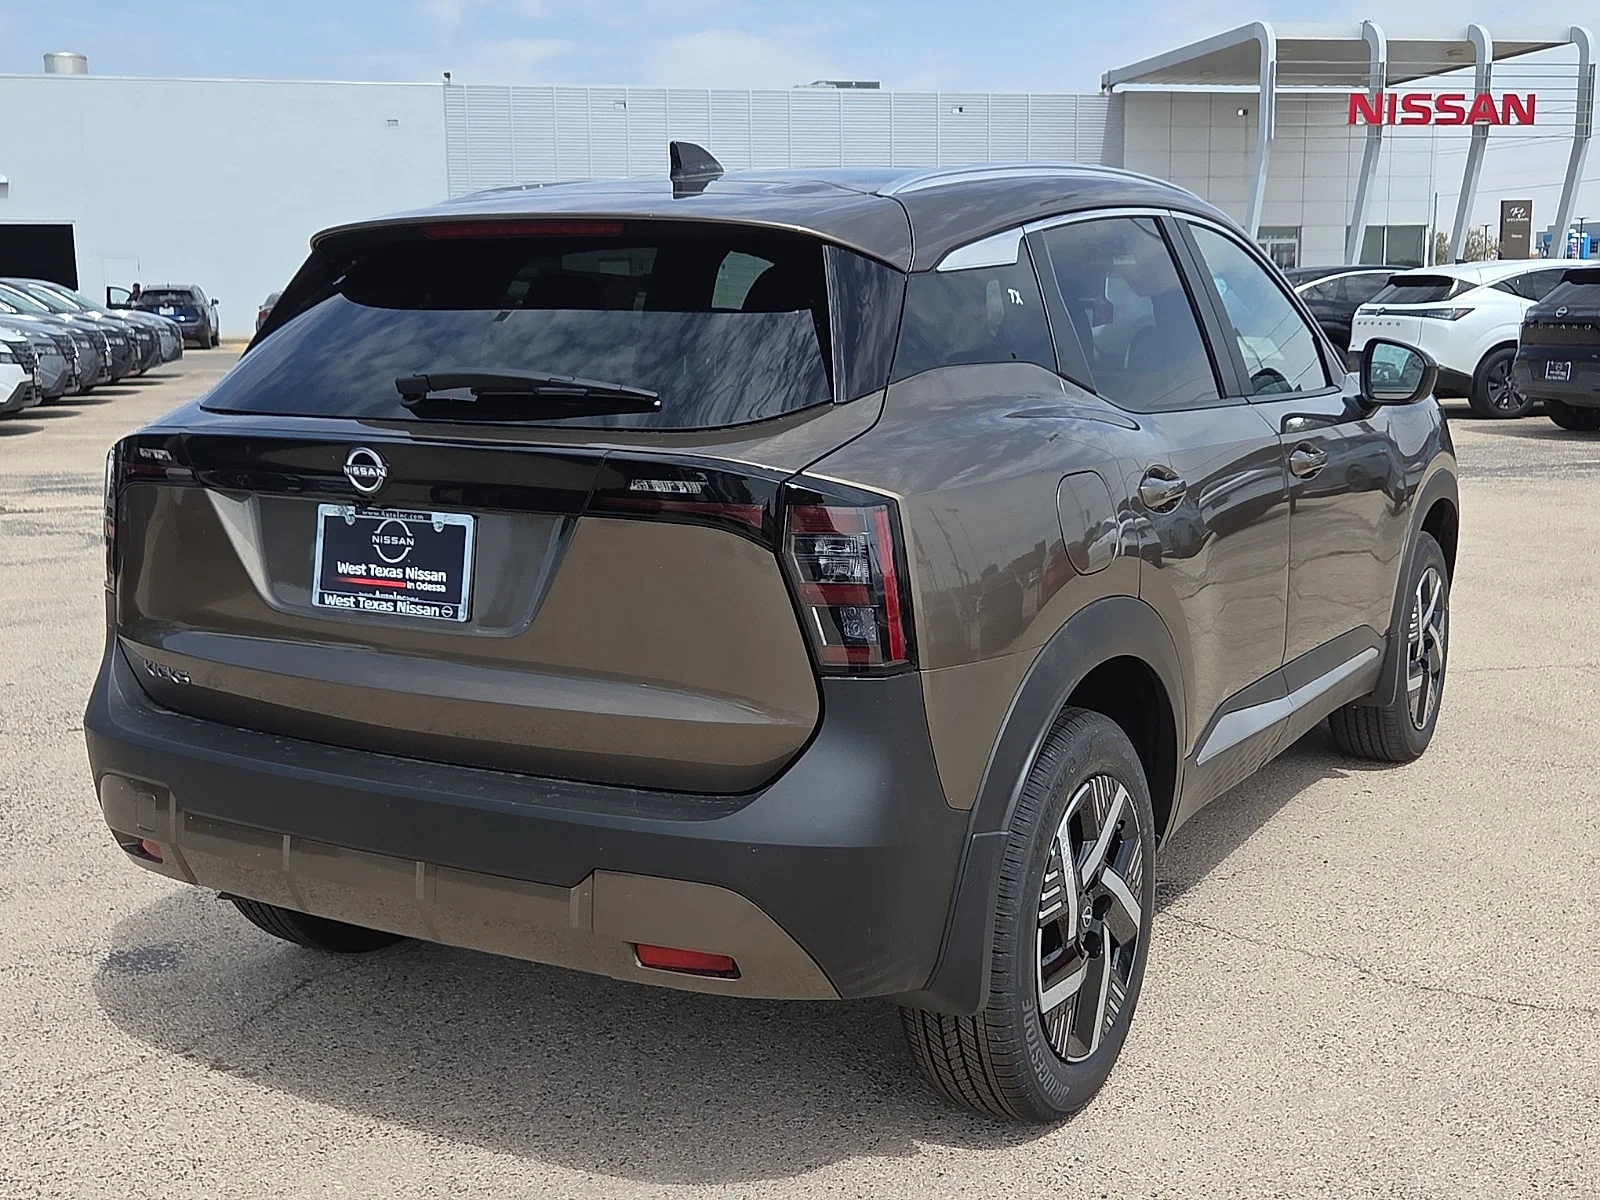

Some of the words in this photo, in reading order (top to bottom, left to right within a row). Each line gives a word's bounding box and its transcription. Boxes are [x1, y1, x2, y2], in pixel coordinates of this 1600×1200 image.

[1348, 93, 1536, 125] NISSAN
[343, 464, 387, 477] NISSAN
[371, 535, 414, 546] NISSAN
[337, 561, 367, 576] West
[368, 563, 403, 579] Texas
[405, 566, 447, 582] Nissan
[416, 581, 446, 592] Odessa
[324, 593, 355, 608] West
[358, 597, 394, 612] Texas
[396, 600, 440, 617] Nissan
[1021, 997, 1070, 1104] BRIDGESTONE
